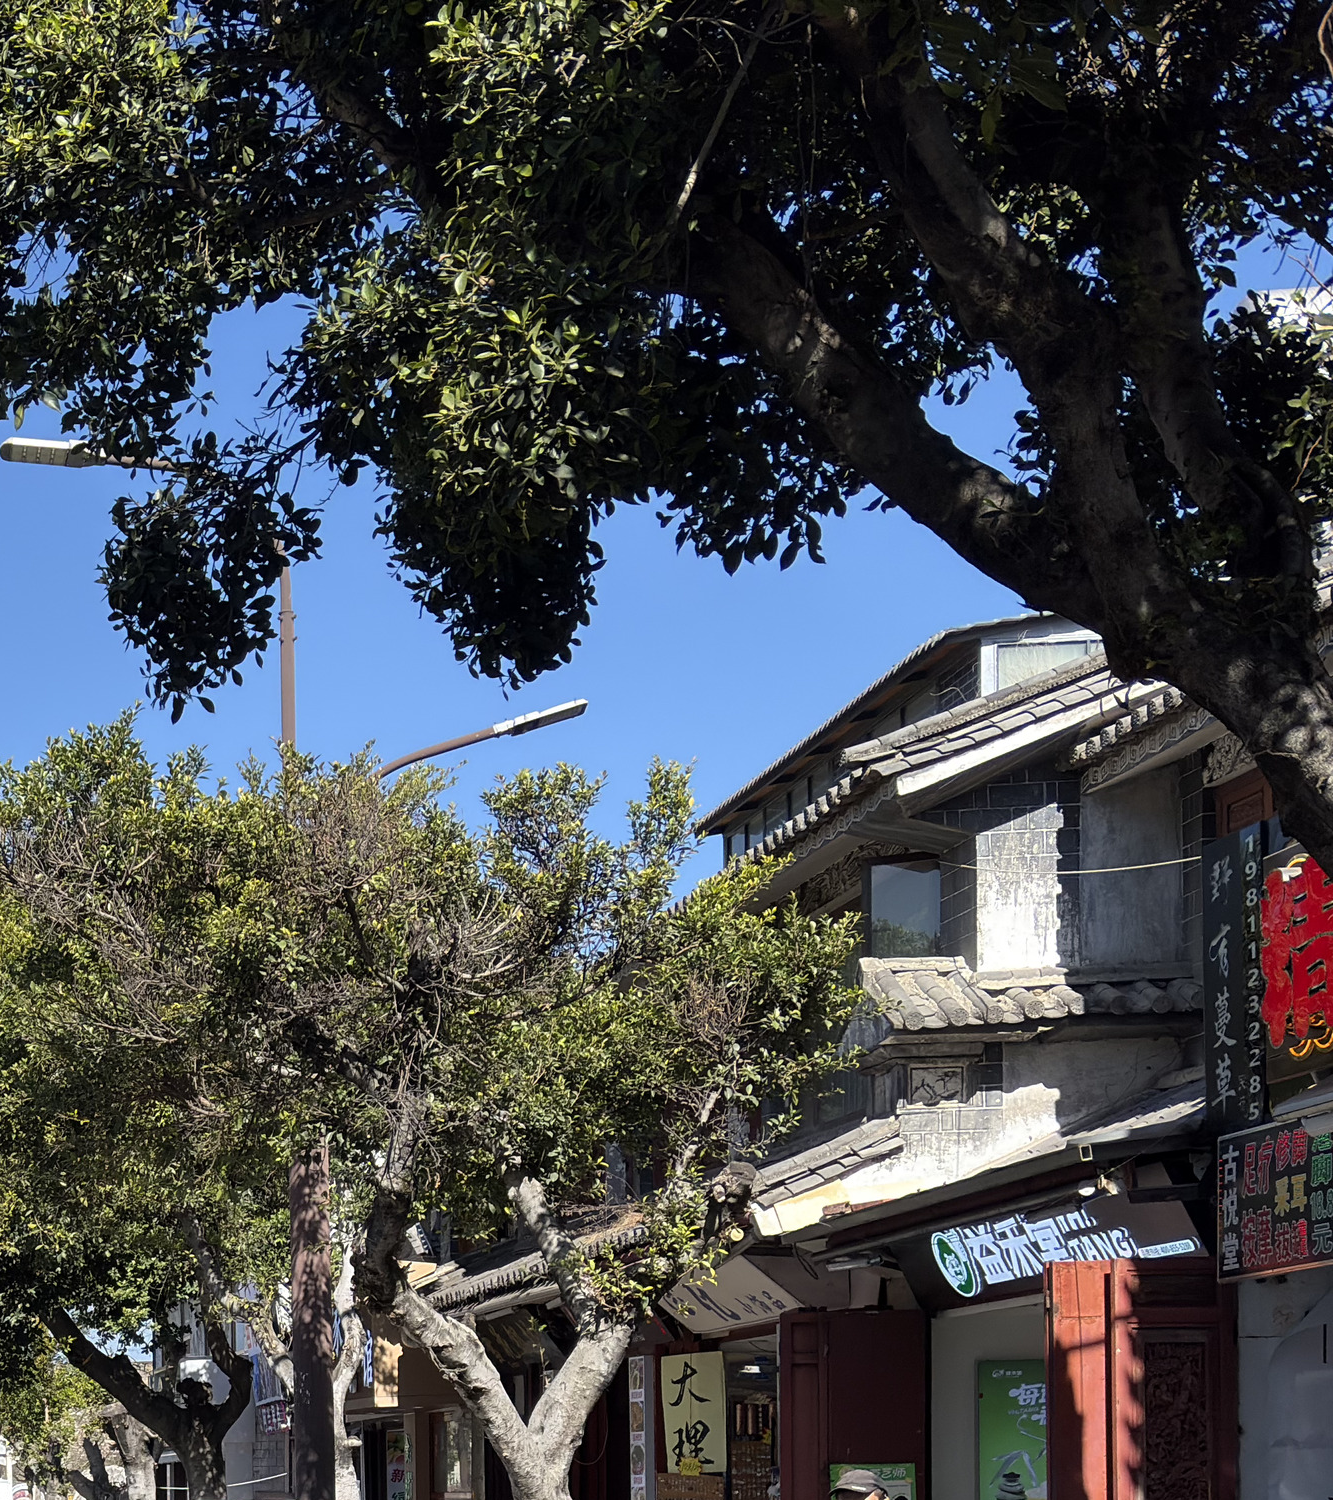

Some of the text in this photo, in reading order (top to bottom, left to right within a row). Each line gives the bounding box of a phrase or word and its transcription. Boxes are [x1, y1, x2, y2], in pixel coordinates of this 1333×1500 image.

[1244, 834, 1261, 1122] 19811232285
[1222, 1144, 1240, 1271] 古悦堂
[1243, 1135, 1274, 1197] 足疗
[1241, 1206, 1273, 1268] 按摩
[1312, 1222, 1333, 1255] 元
[669, 1361, 724, 1466] 大理
